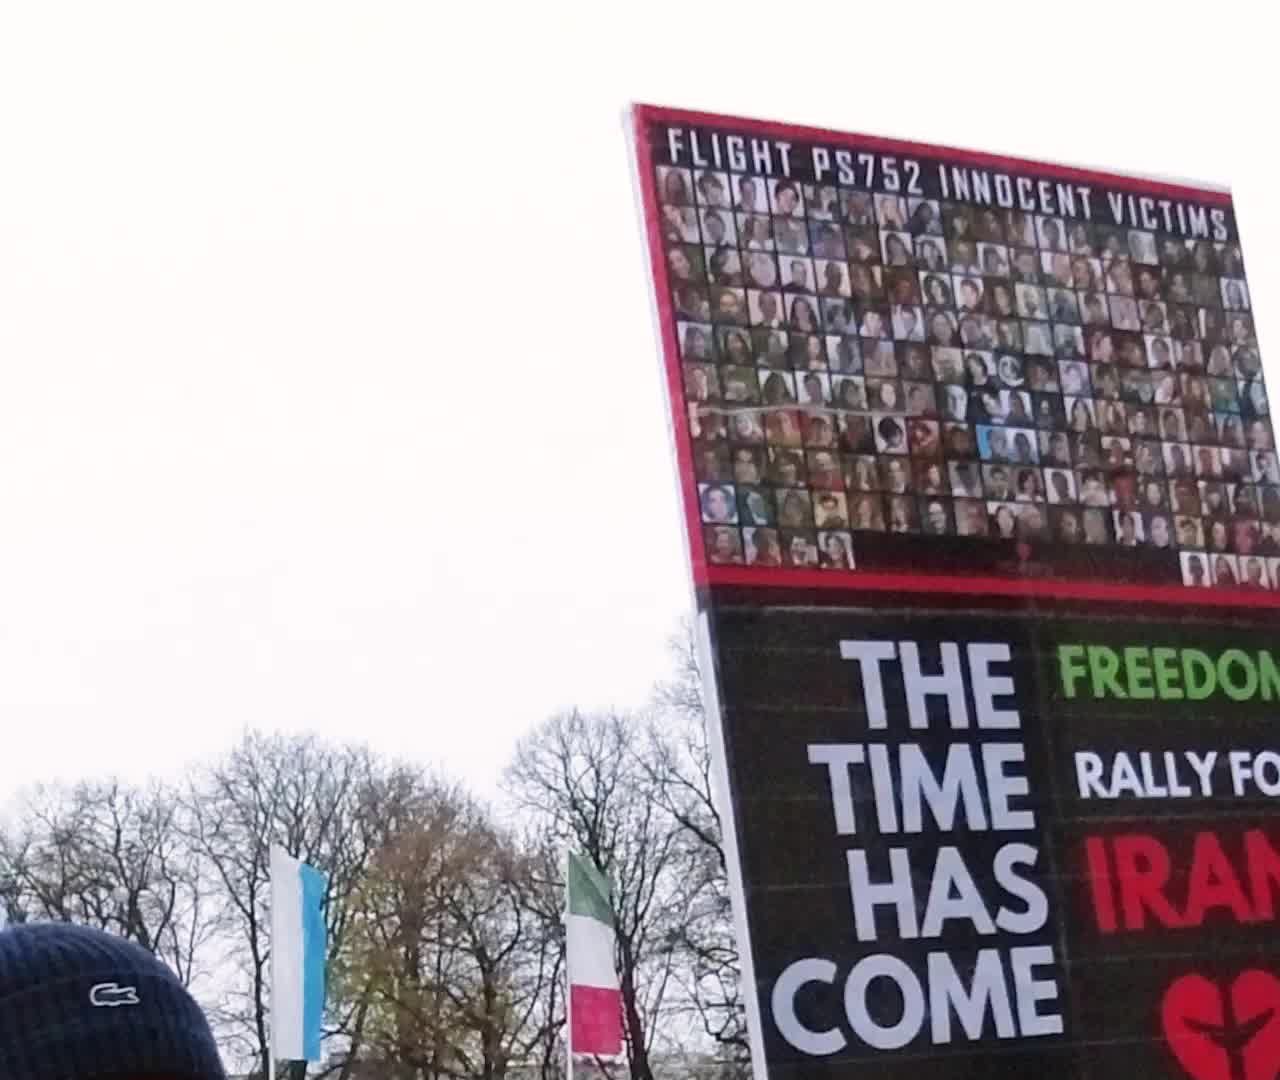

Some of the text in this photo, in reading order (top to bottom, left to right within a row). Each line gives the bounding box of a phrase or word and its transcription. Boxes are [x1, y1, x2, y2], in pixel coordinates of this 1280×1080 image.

[667, 128, 1228, 240] FLIGHT PS752 INNOCENT VICTIMS
[841, 641, 1019, 730] THE
[808, 743, 1035, 834] TIME
[1075, 751, 1216, 798] RALLY
[847, 843, 1049, 941] HAS
[772, 946, 1064, 1057] COME
